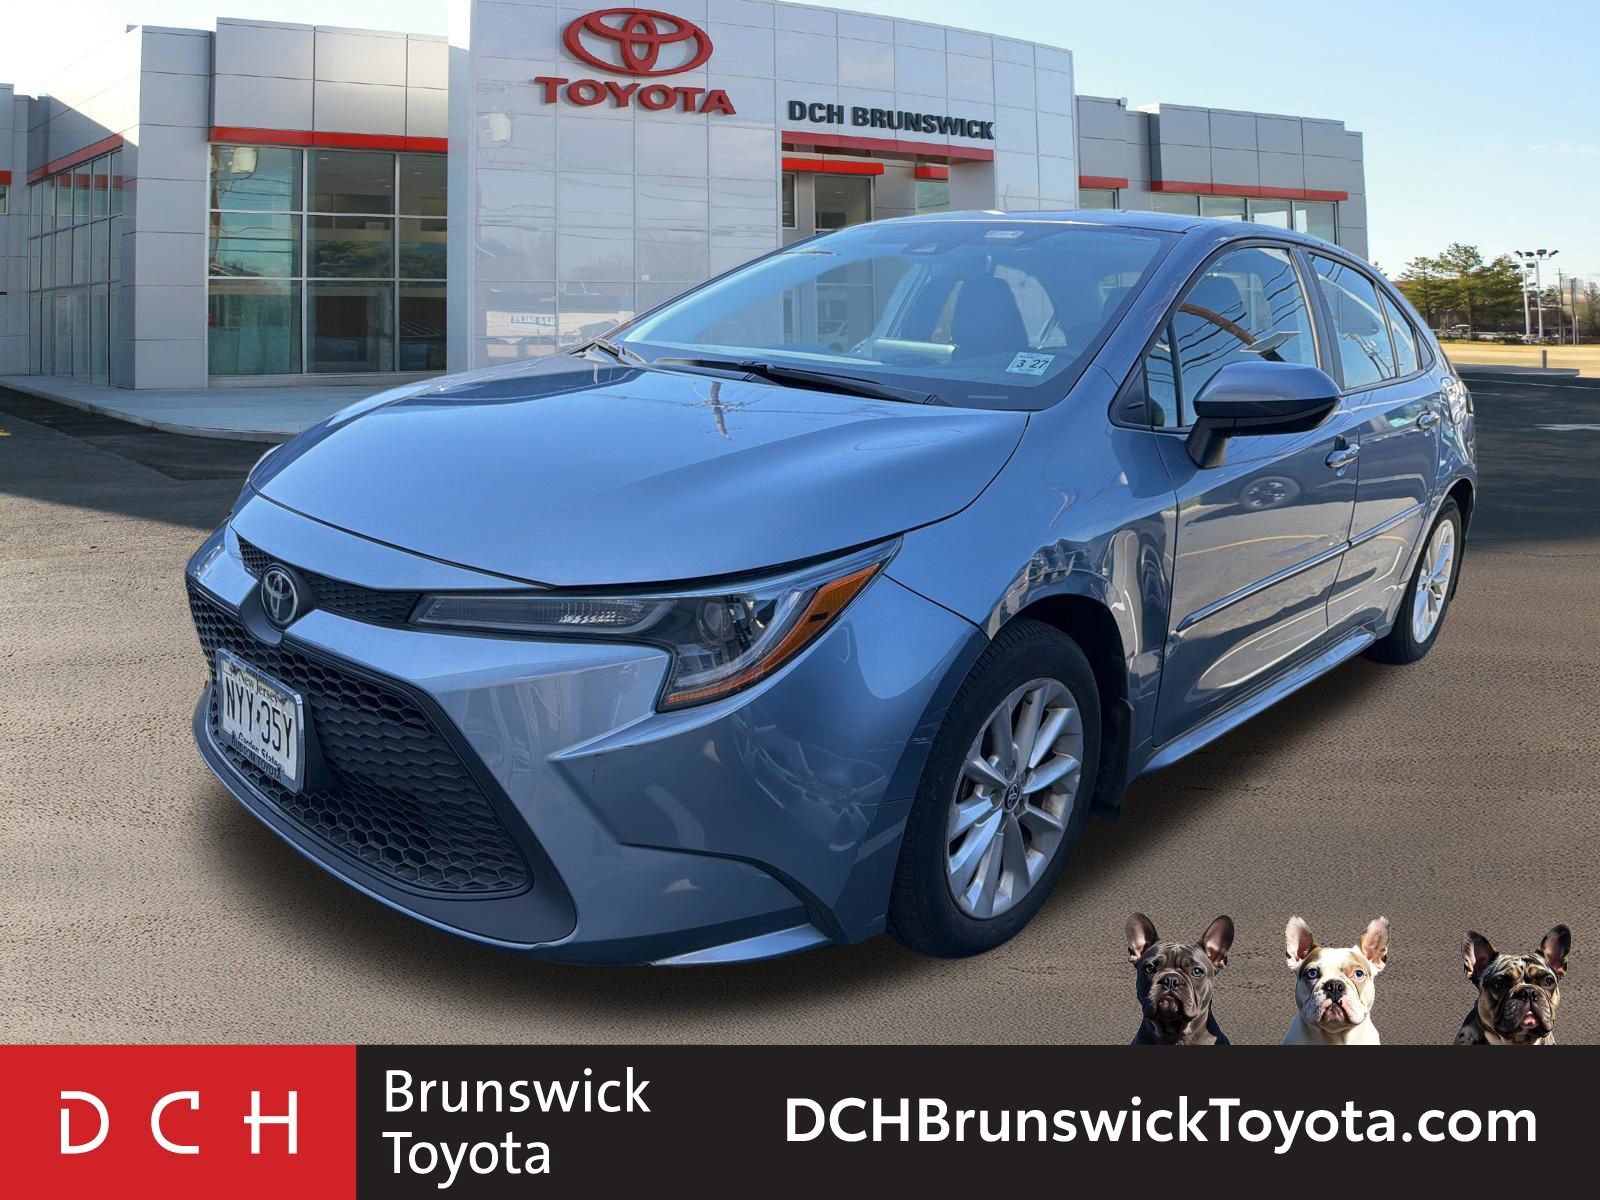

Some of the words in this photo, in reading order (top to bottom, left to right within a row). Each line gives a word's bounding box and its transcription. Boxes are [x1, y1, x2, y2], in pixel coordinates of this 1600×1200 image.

[534, 76, 737, 116] TOYOTA
[788, 100, 845, 126] DCH
[851, 106, 995, 141] BRUNSWICK
[1029, 359, 1049, 369] 27
[256, 679, 281, 706] Jersey
